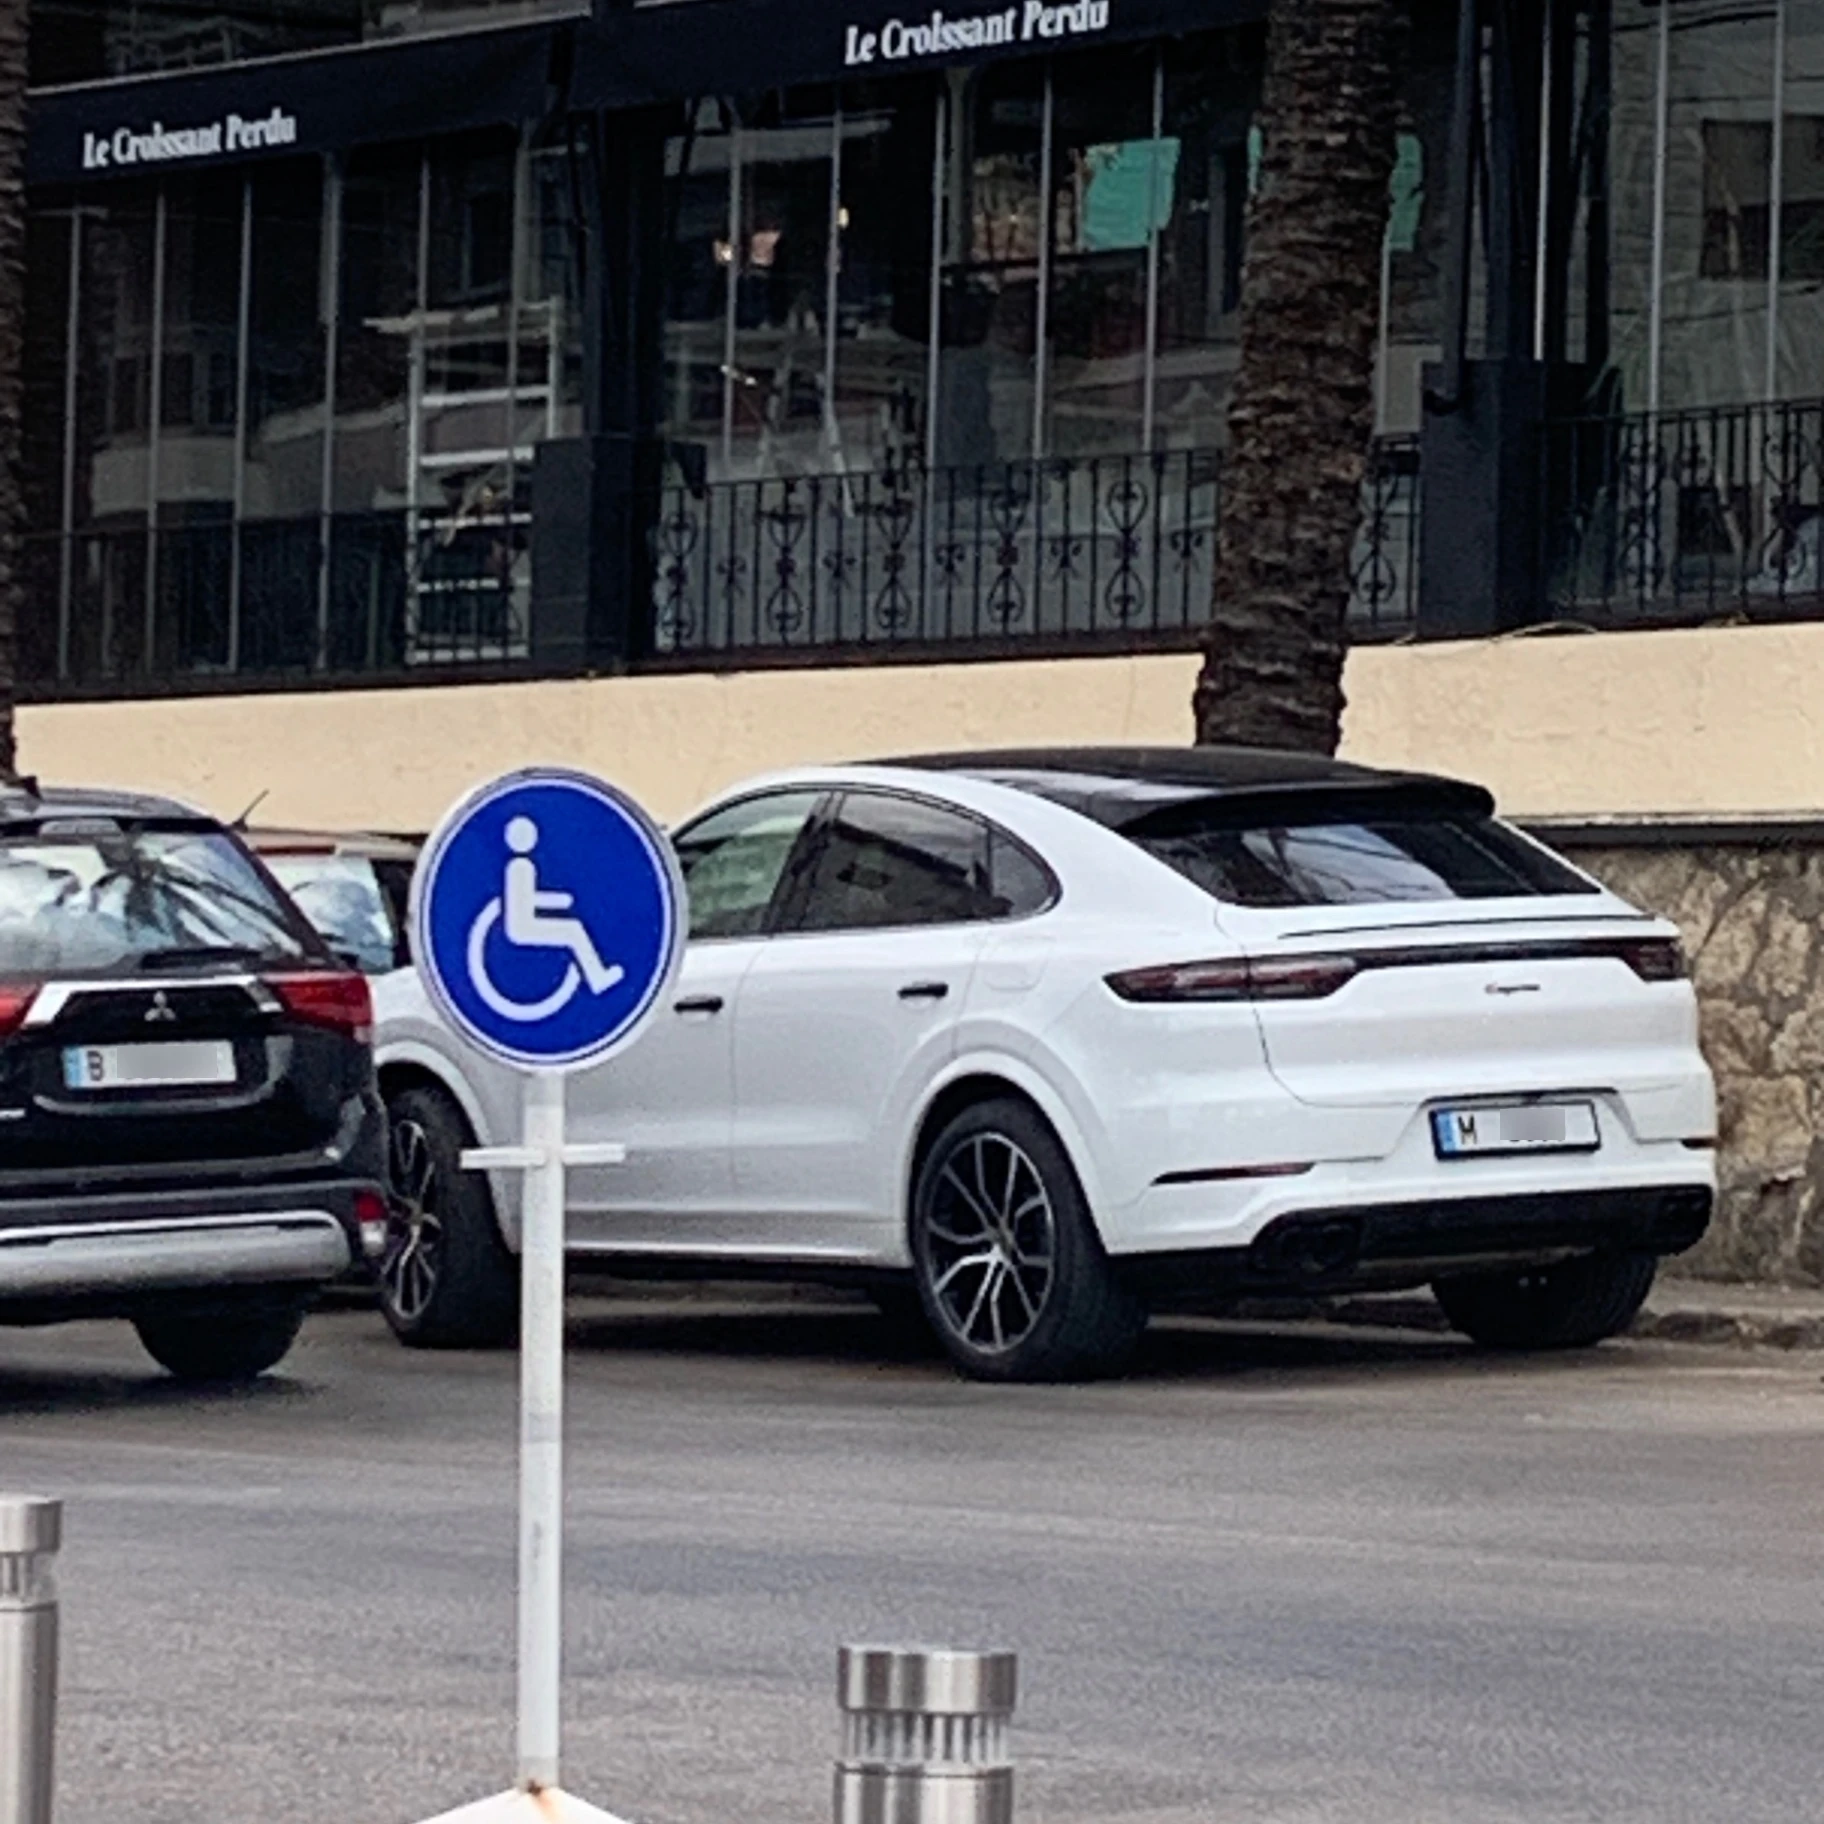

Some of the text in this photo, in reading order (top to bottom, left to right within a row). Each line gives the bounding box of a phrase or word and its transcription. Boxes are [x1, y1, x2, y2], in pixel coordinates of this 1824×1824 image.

[844, 0, 1109, 65] Le Croissant Perdu
[83, 106, 297, 168] Le Croissant Perdu
[87, 1050, 104, 1082] B
